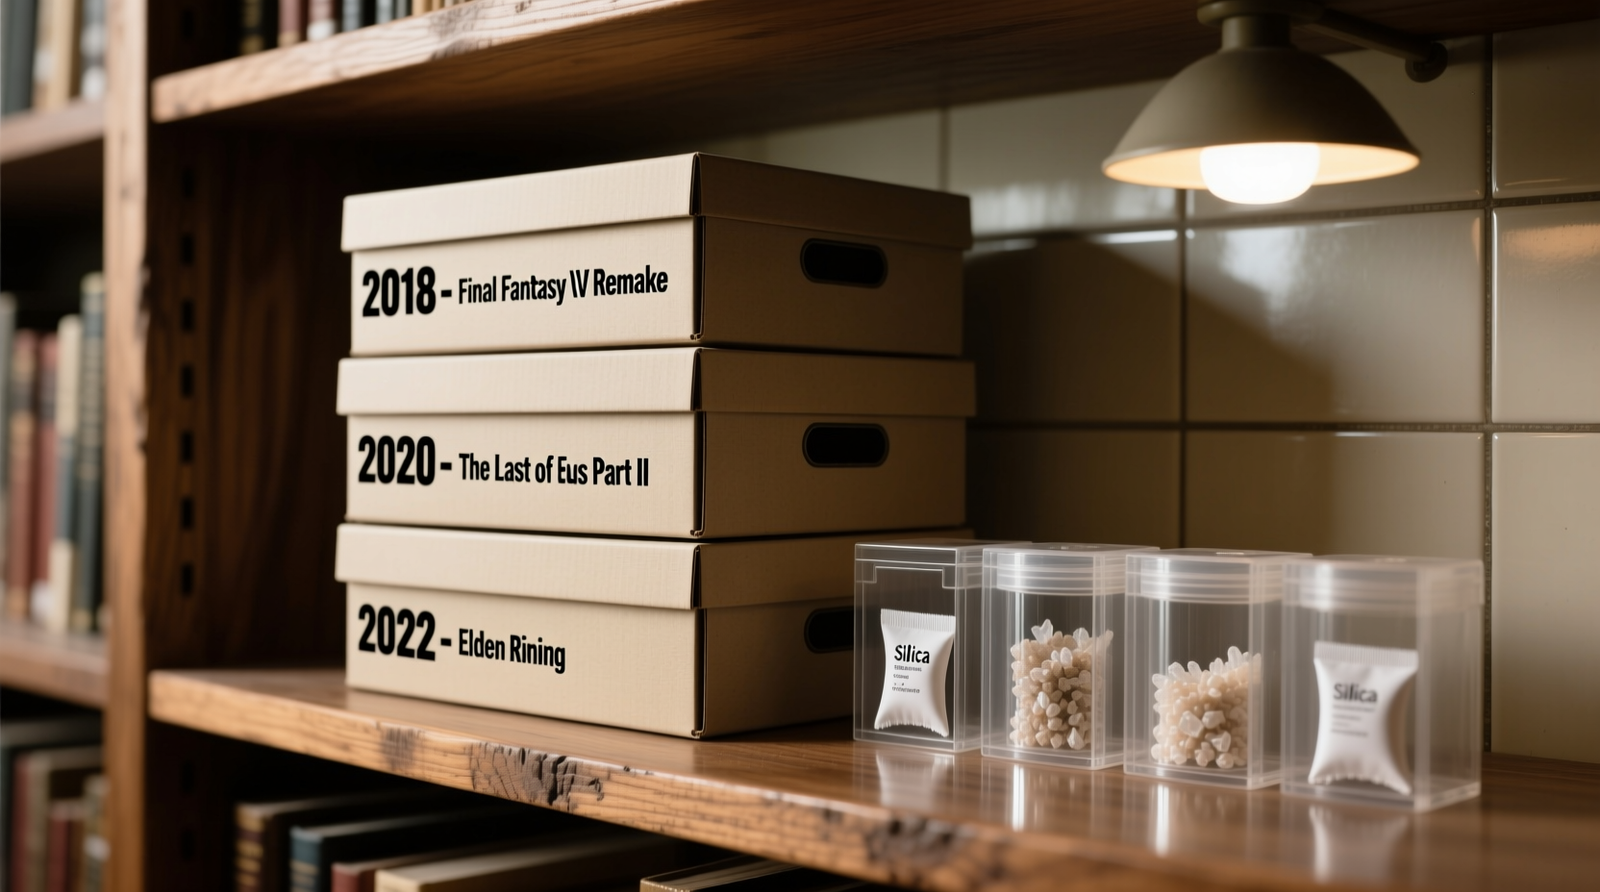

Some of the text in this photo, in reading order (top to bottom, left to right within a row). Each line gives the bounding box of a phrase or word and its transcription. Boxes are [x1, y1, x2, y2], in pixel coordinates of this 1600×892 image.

[362, 266, 436, 317] 2018
[458, 276, 496, 304] Final
[501, 275, 566, 306] Fantasy
[593, 265, 668, 296] Remake
[358, 435, 435, 486] 2020
[458, 453, 490, 481] The
[494, 454, 531, 482] Last
[534, 455, 554, 483] of
[557, 456, 588, 485] Eus
[592, 457, 632, 485] Part
[358, 604, 435, 661] 2022
[458, 628, 505, 660] Elden
[509, 635, 565, 674] Rining
[894, 644, 930, 664] Silica
[1333, 682, 1378, 703] Silica
